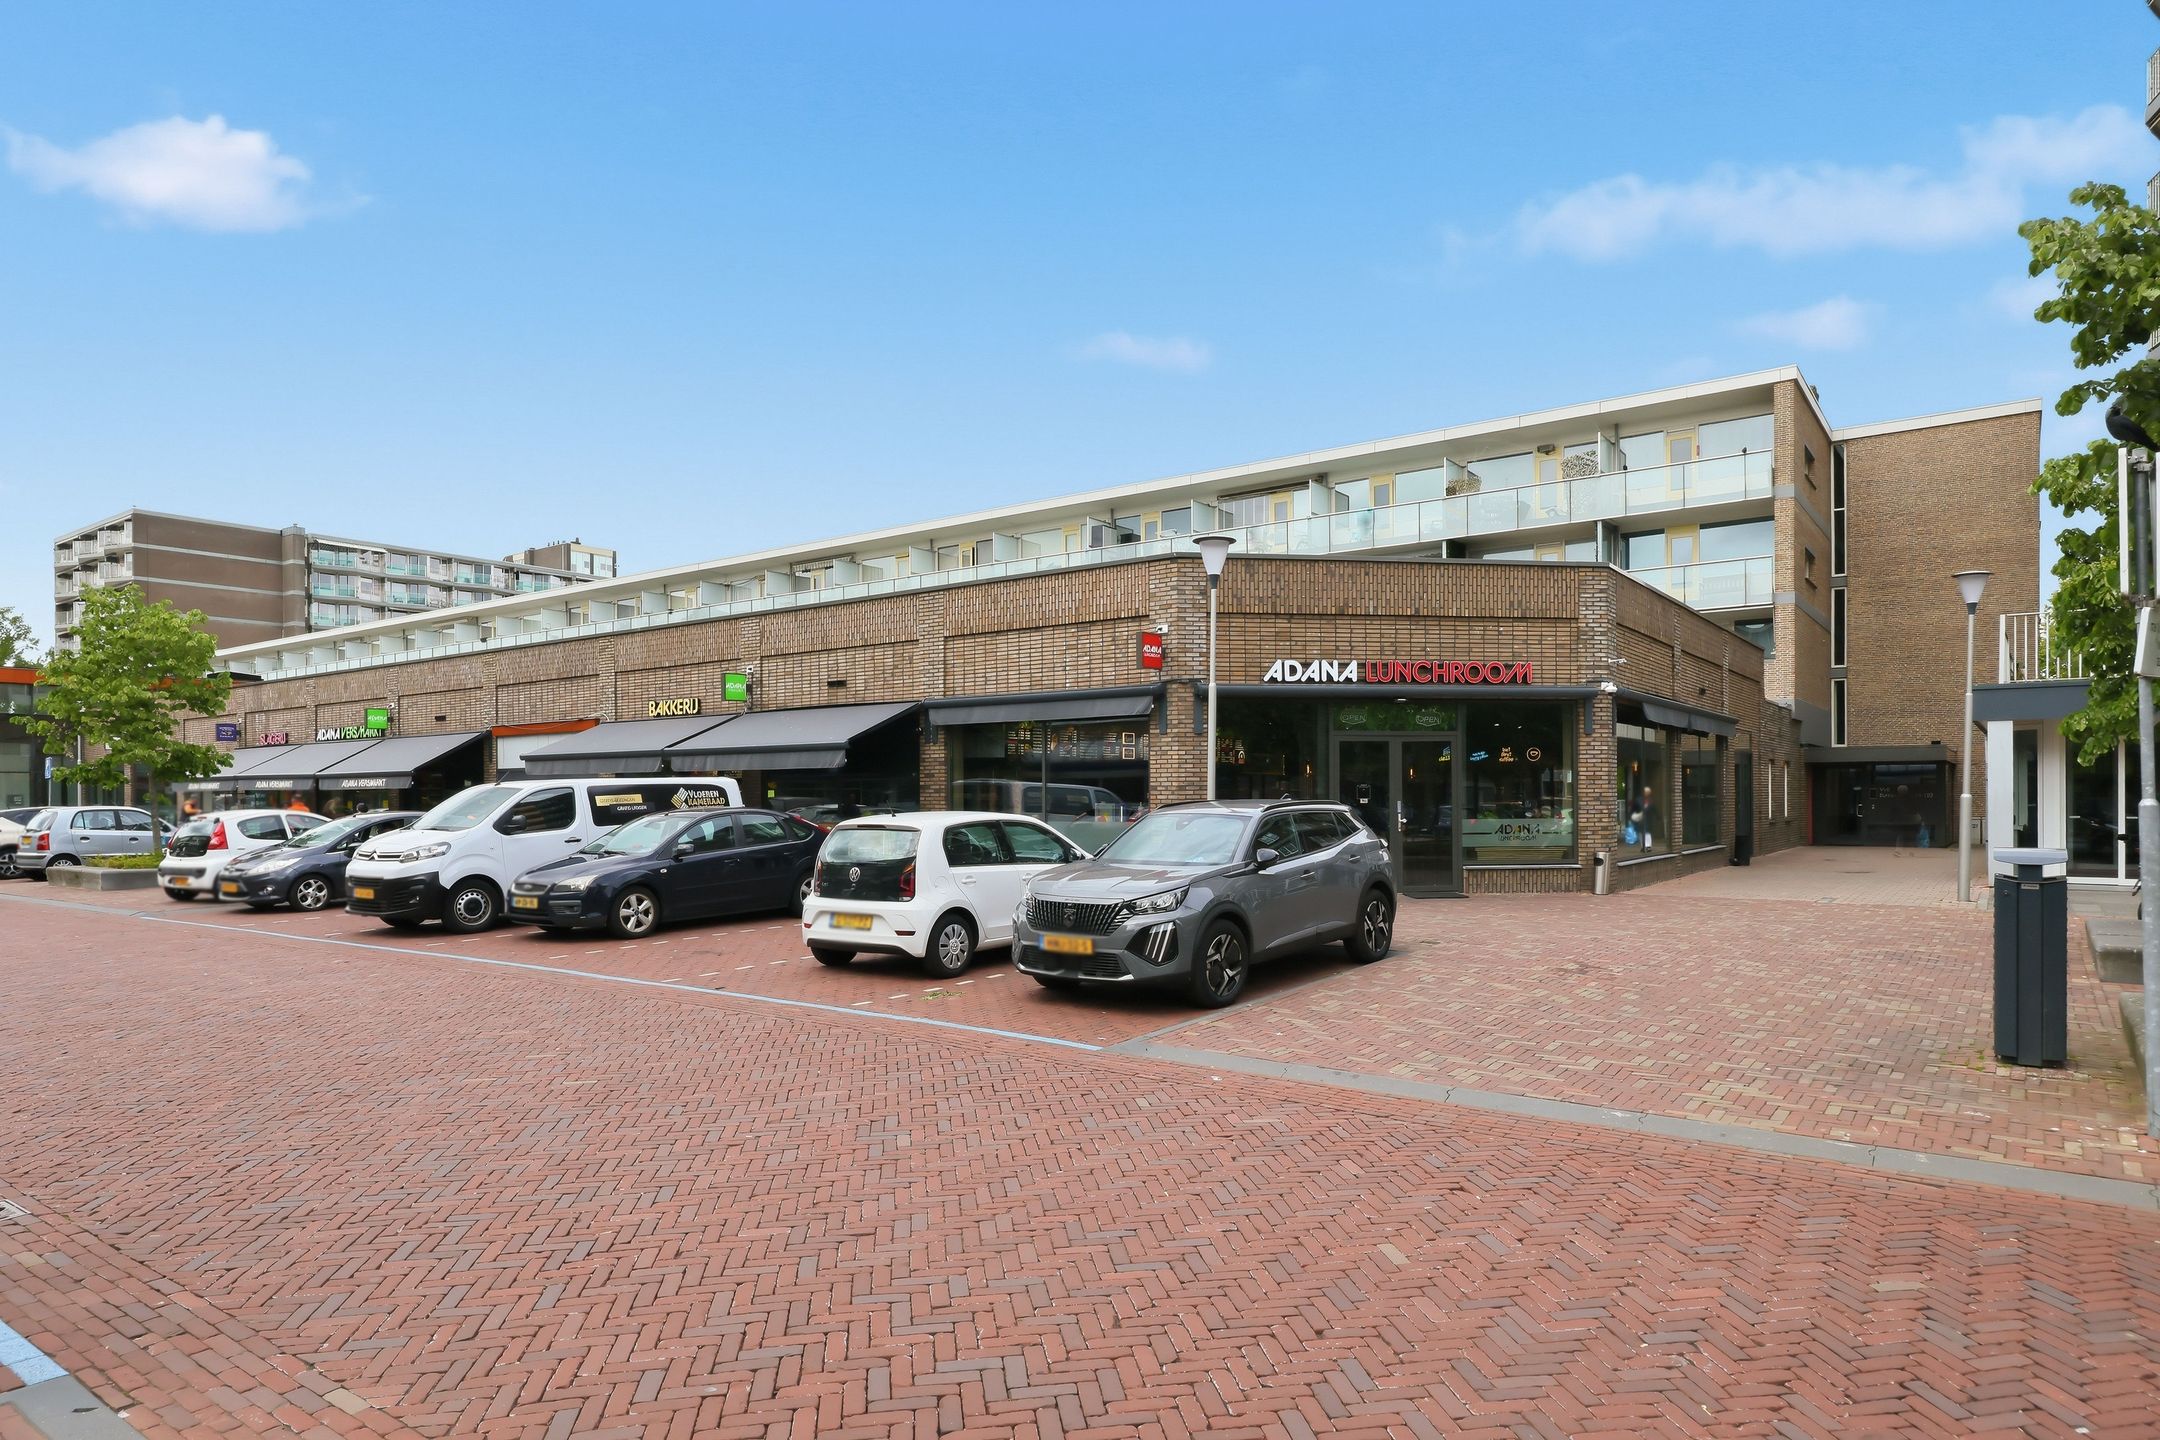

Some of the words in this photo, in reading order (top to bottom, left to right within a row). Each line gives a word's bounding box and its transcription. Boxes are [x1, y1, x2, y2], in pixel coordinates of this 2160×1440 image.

[1263, 659, 1358, 683] ADANA
[1365, 660, 1533, 684] LUNCHROOM
[648, 697, 699, 716] BAKKERIJ
[316, 727, 340, 741] ADANA
[358, 779, 386, 787] VERSMARKT
[687, 797, 726, 806] KAMERAAD
[1494, 823, 1541, 835] ADANA
